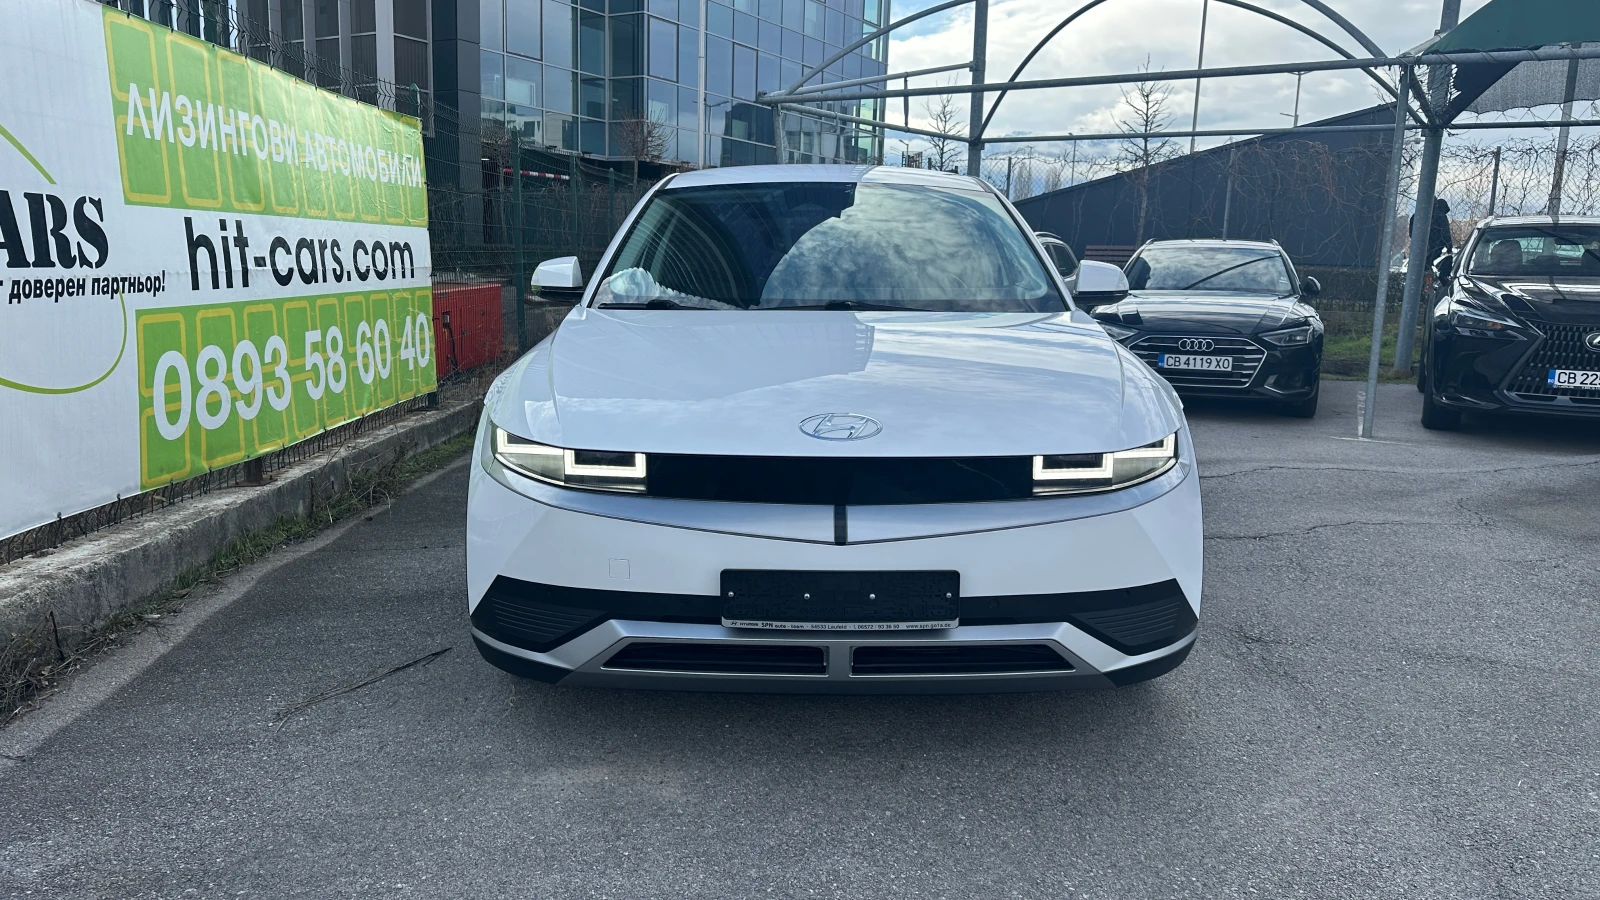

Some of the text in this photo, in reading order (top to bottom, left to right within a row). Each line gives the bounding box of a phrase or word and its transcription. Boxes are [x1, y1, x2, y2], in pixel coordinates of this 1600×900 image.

[126, 82, 422, 188] ЛИЗИНГОВИ АВТОМОБИЛИ
[184, 216, 415, 291] hit-cars.com
[8, 270, 166, 304] доверен партньор!
[153, 312, 430, 440] 0893 58 60 40
[1166, 355, 1181, 367] CB
[1183, 356, 1212, 369] 4119
[1557, 371, 1600, 386] CB 22
